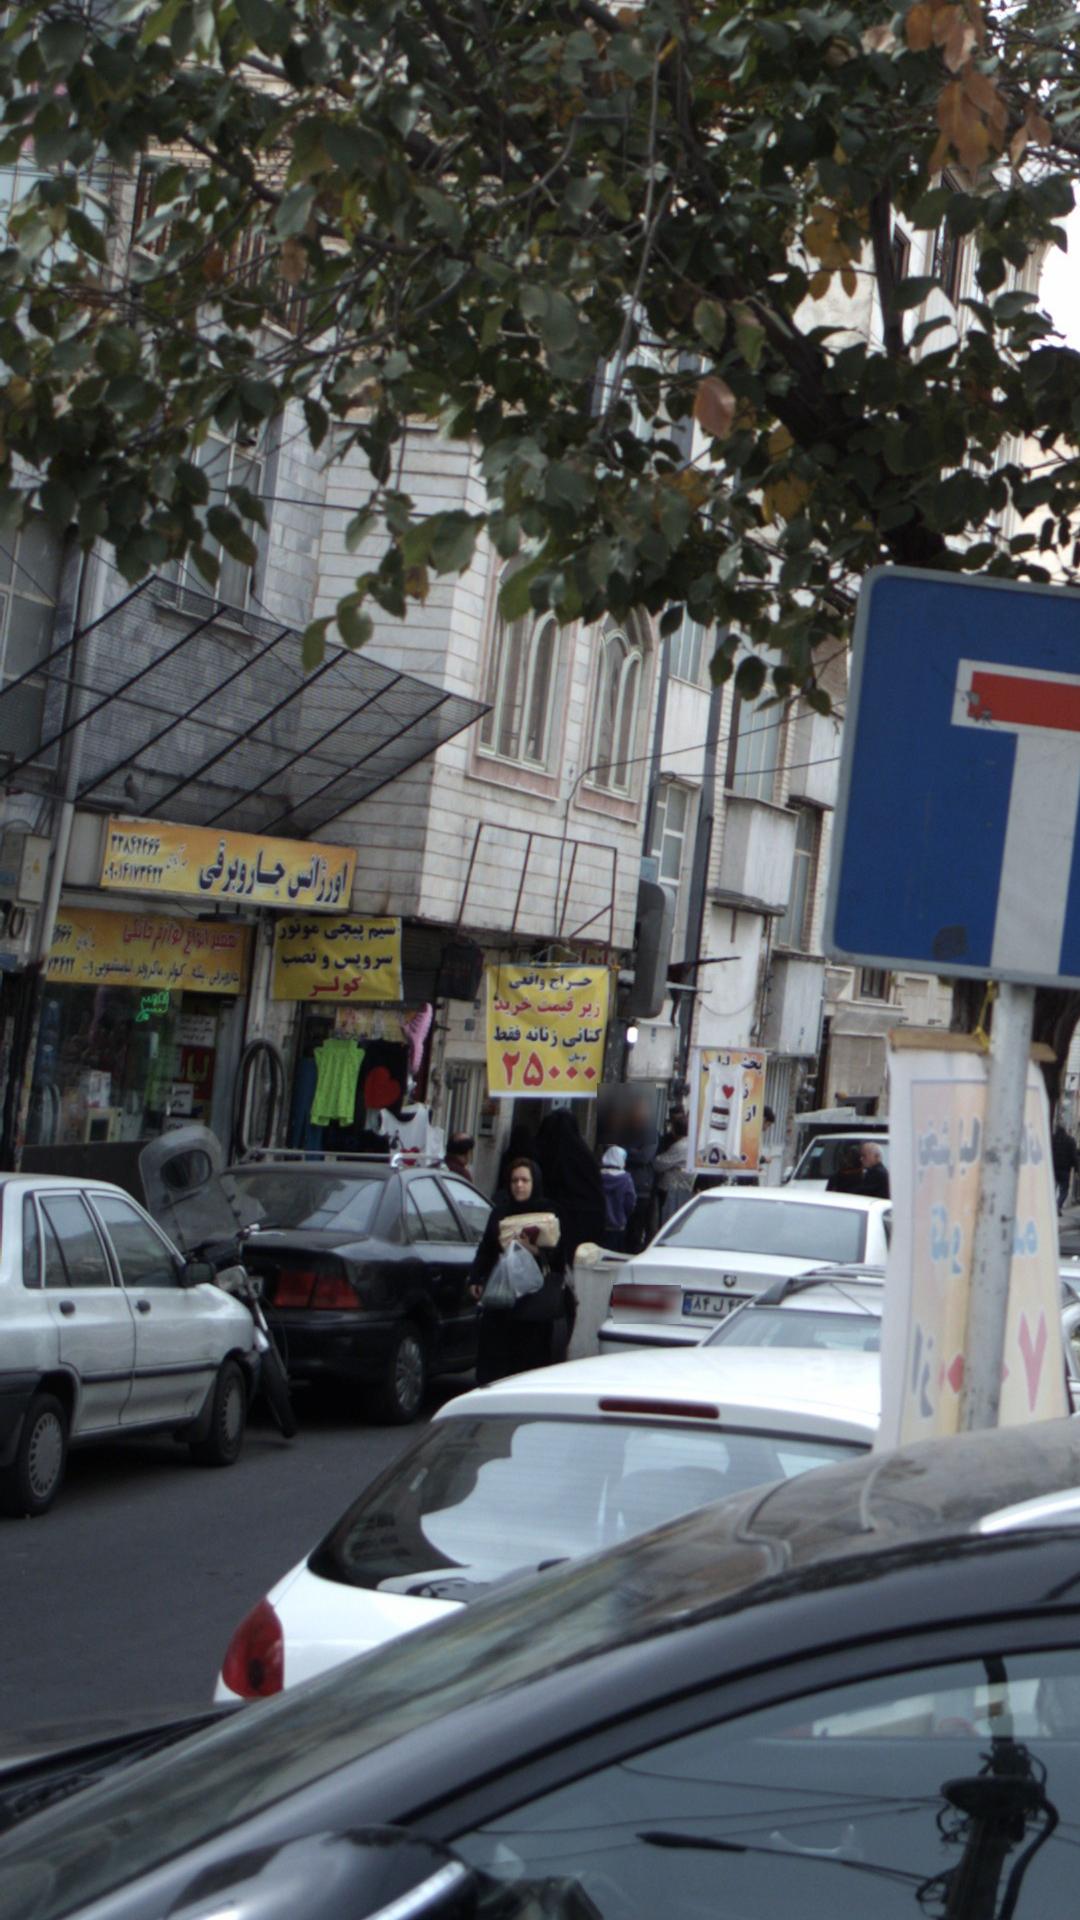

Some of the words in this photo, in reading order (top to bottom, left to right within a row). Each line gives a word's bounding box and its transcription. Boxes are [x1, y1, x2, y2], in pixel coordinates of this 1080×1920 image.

[199, 840, 285, 895] جاروبرقی
[323, 923, 364, 941] پیچی
[368, 926, 396, 940] سیم
[282, 947, 317, 968] نصب
[321, 954, 330, 970] و
[334, 953, 393, 970] سرویس
[308, 975, 364, 998] کولر
[508, 972, 545, 991] واقعی
[549, 974, 592, 991] حراج
[494, 997, 532, 1016] خرید
[537, 996, 575, 1016] قیمت
[578, 1002, 600, 1018] زیر
[494, 1024, 522, 1042] فقط
[525, 1024, 558, 1048] زنانه
[502, 1051, 596, 1087] ۲۵۰۰۰
